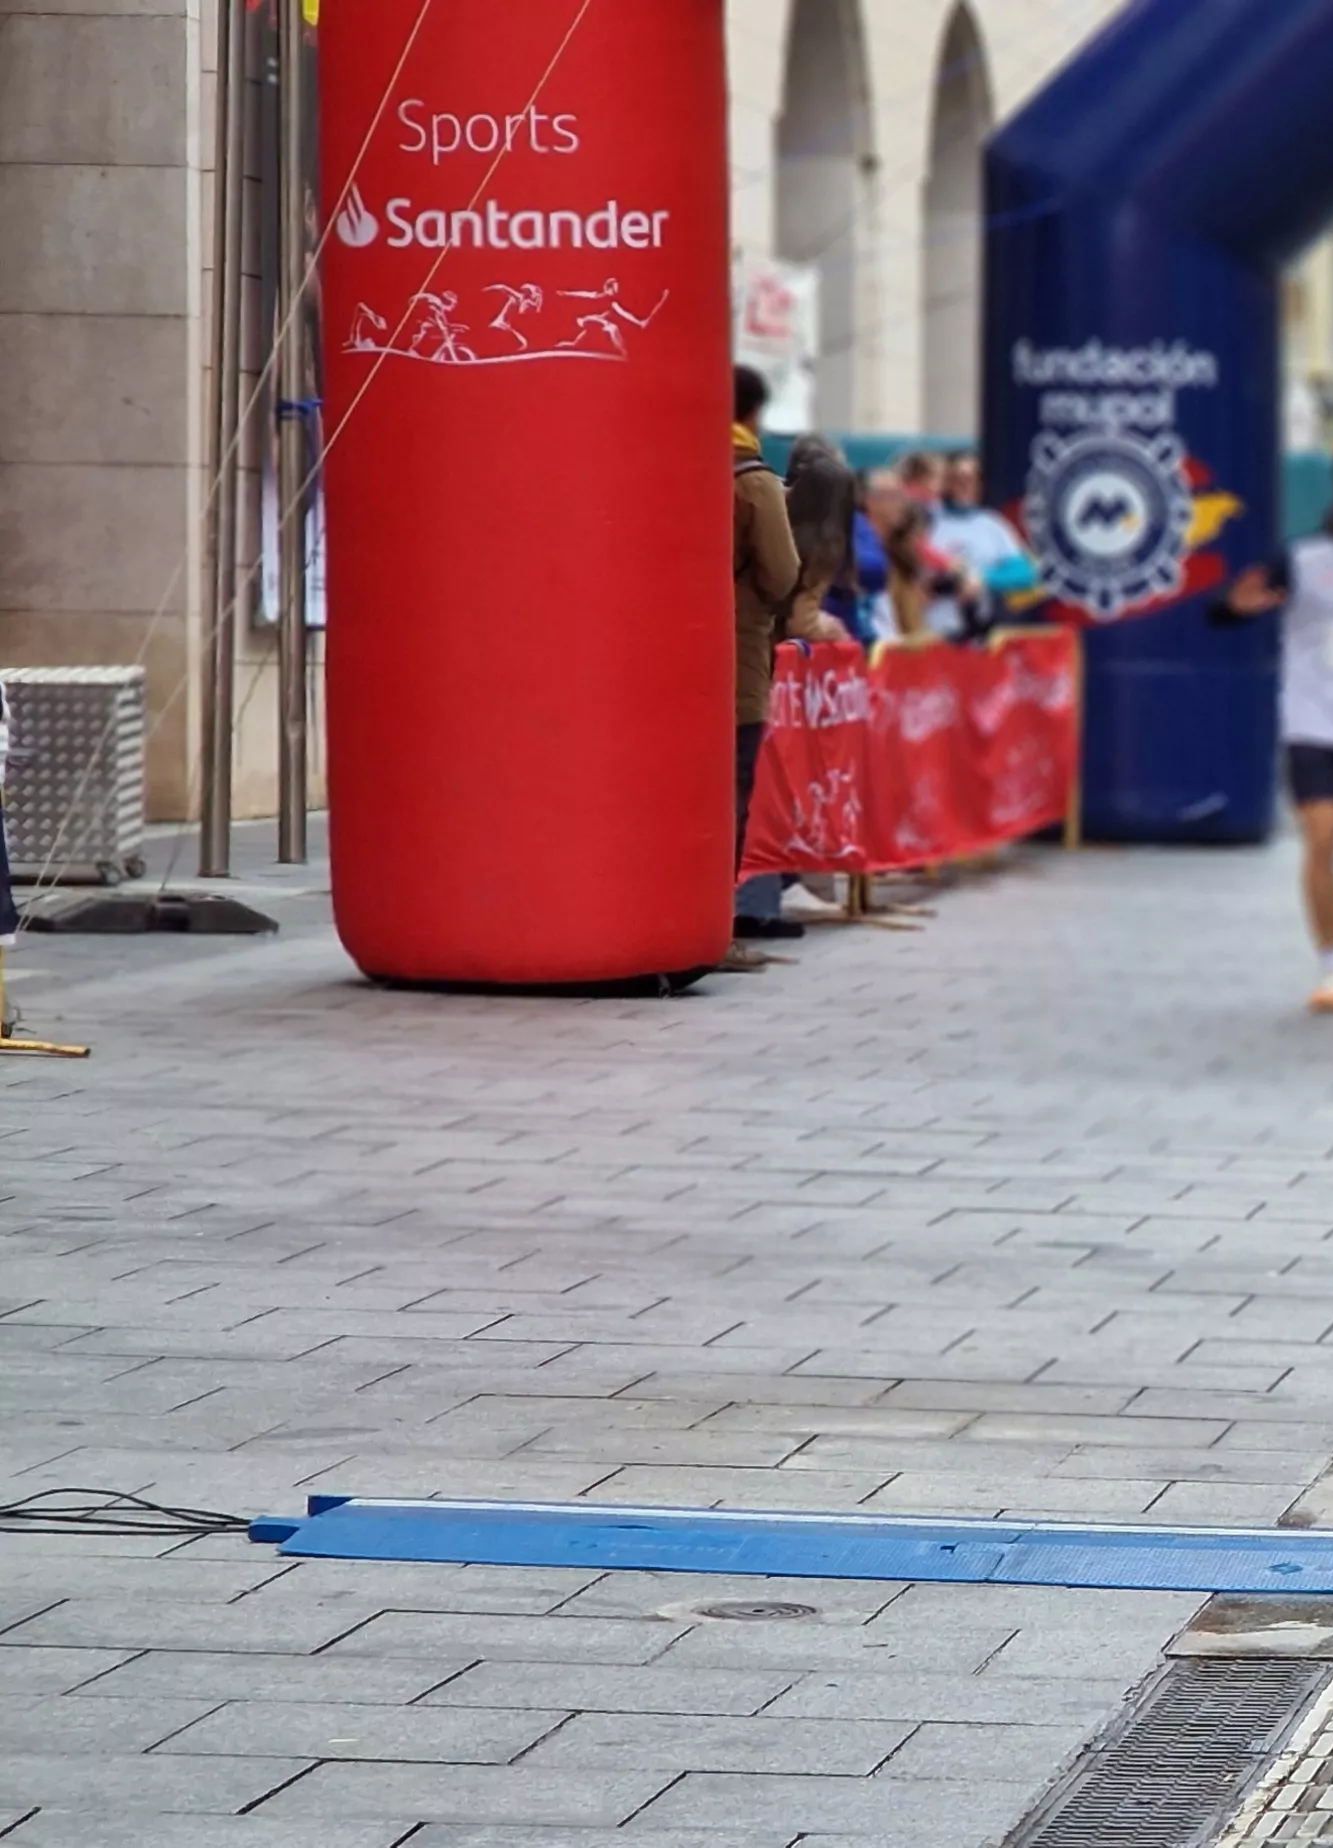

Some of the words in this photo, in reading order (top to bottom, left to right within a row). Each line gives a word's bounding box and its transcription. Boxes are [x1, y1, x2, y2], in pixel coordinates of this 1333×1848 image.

[398, 98, 580, 166] Sports
[385, 197, 671, 250] Santander
[1012, 335, 1218, 387] fundación
[1040, 387, 1175, 438] mupol
